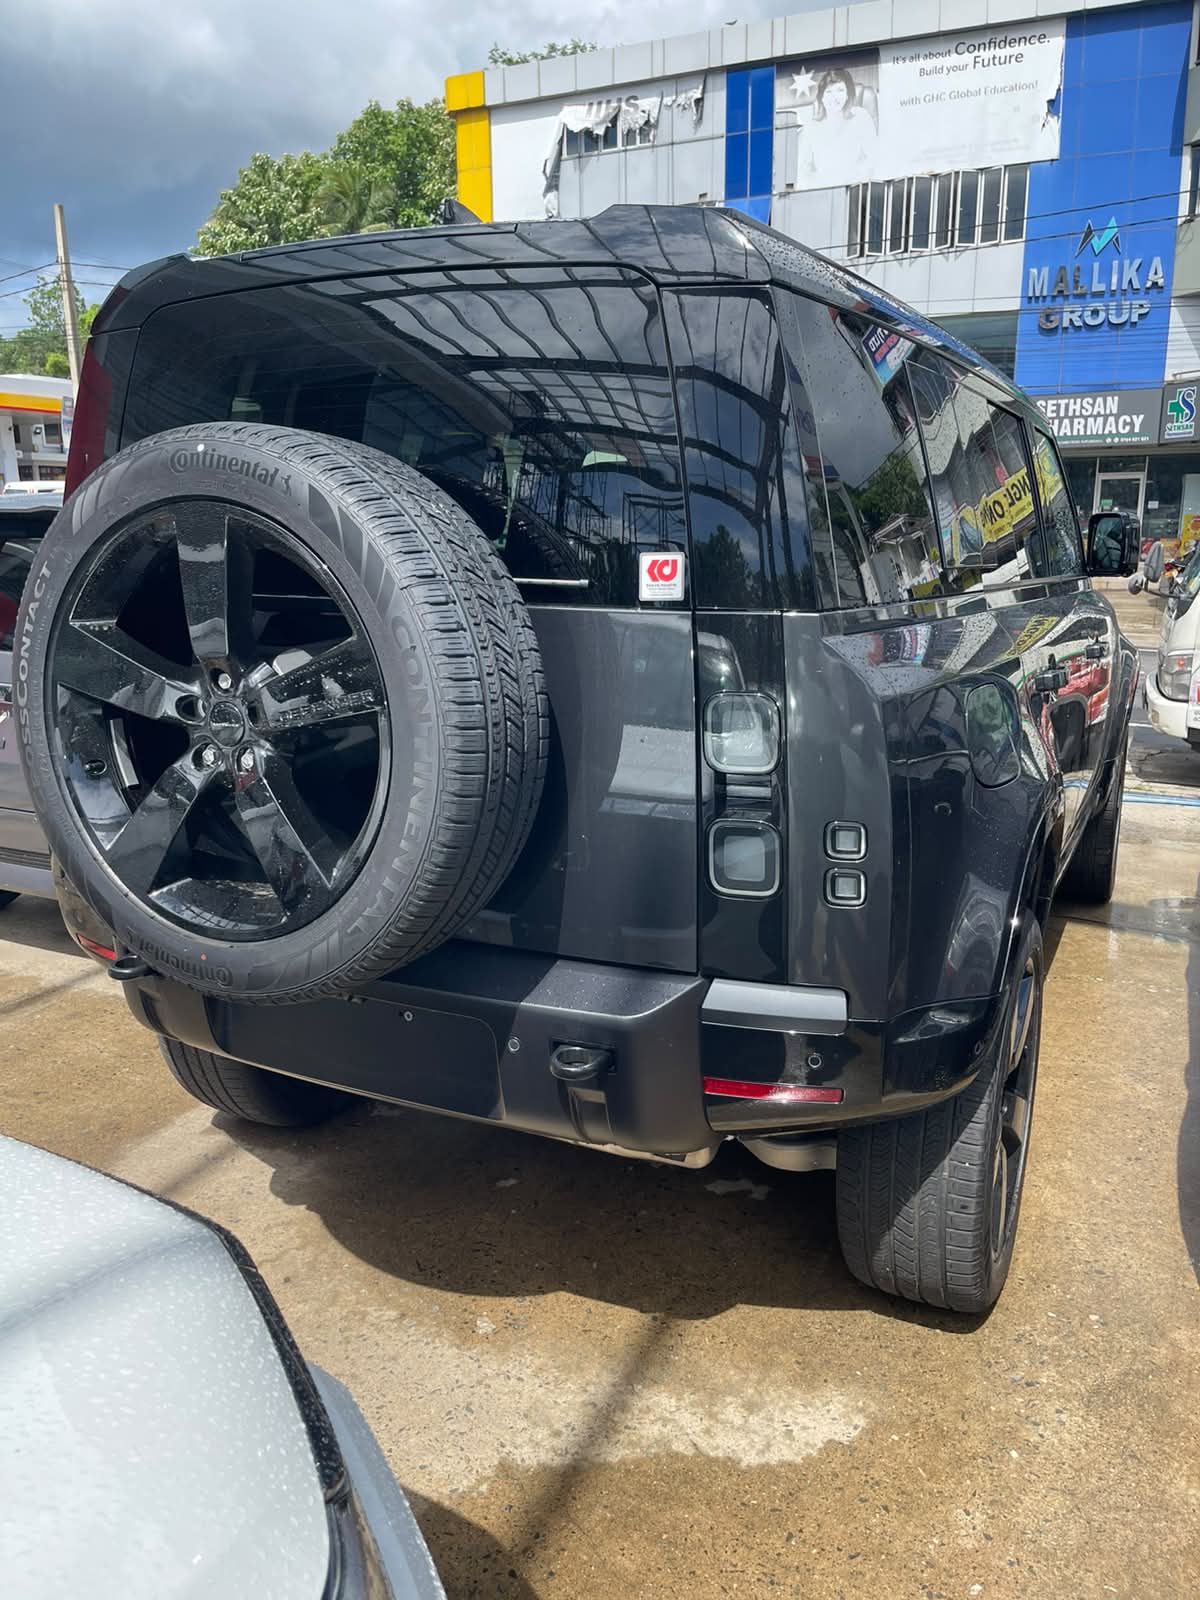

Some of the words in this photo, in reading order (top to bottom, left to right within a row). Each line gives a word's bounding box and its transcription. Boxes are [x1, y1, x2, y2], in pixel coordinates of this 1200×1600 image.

[892, 56, 906, 65] It's
[909, 52, 920, 63] all
[922, 49, 951, 62] about
[954, 32, 1050, 56] Confidence.
[919, 65, 944, 77] Build
[946, 63, 969, 76] your
[973, 52, 1024, 69] Future
[899, 97, 921, 107] with
[923, 92, 946, 104] GHC
[949, 87, 982, 101] Global
[984, 80, 1038, 96] Education!
[1027, 256, 1165, 299] MALLIKA
[1039, 300, 1151, 330] GROUP
[1036, 395, 1119, 418] SETHSAN
[1050, 414, 1145, 437] HARMACY
[170, 447, 280, 488] Continental
[347, 615, 434, 935] CONTINENTAL
